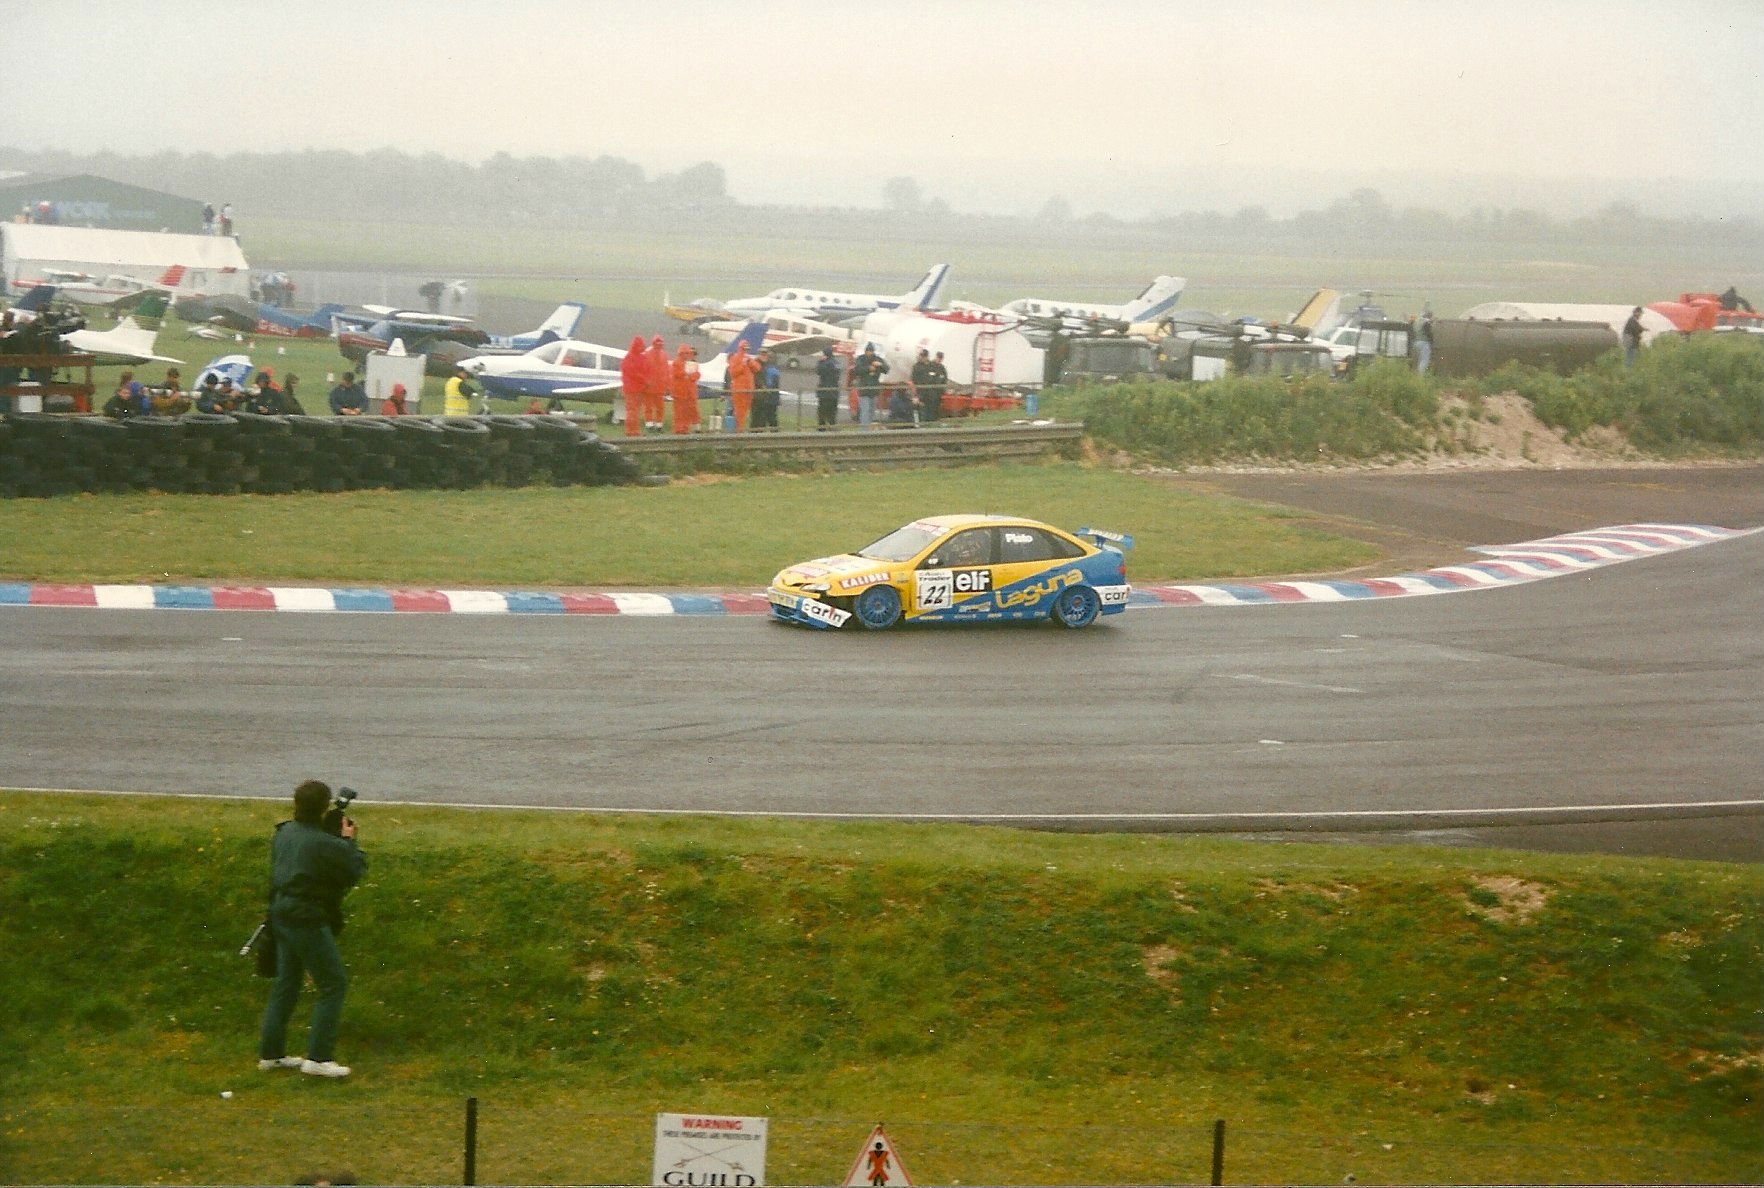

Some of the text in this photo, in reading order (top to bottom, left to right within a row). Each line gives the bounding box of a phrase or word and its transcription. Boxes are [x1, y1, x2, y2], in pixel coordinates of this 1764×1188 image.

[841, 572, 890, 589] KALIBER
[955, 571, 990, 591] elf
[923, 585, 946, 605] 22
[803, 603, 842, 623] carin
[682, 1118, 742, 1130] WARNING
